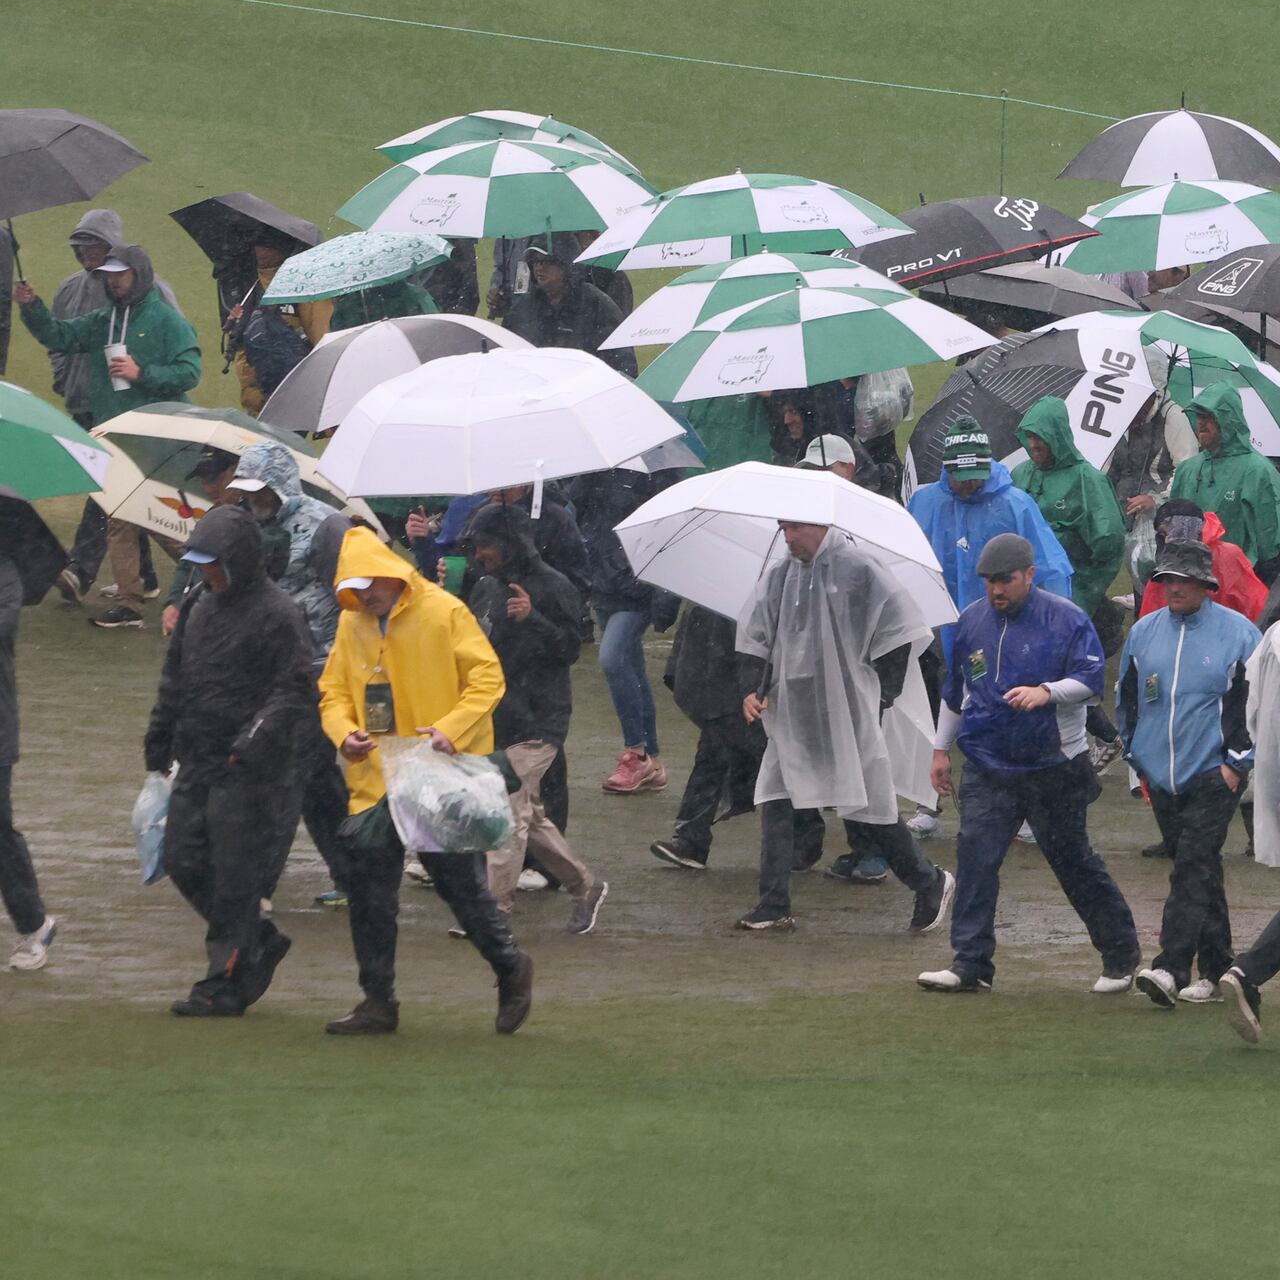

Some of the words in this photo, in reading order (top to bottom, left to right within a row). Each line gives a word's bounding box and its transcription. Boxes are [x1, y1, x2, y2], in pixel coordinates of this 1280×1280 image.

[886, 257, 934, 278] PRO
[936, 247, 962, 263] V1
[1202, 281, 1237, 294] PING
[1080, 347, 1136, 438] PING
[944, 433, 990, 447] CHICAGO
